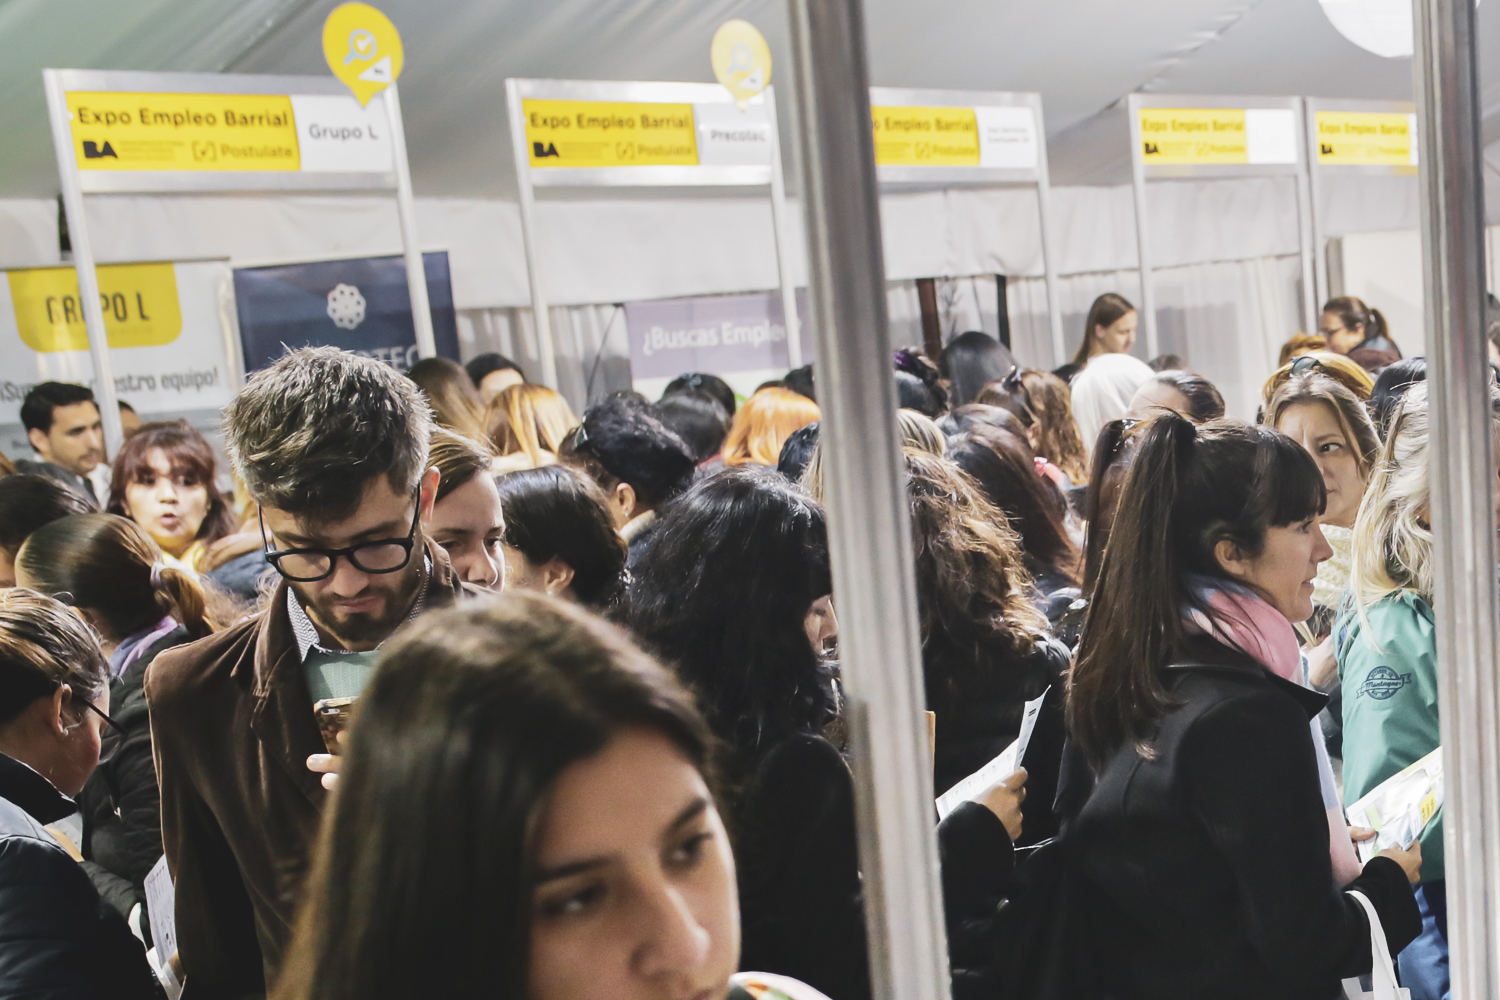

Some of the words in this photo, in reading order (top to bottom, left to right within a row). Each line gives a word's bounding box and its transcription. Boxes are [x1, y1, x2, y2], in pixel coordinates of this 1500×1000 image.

[77, 107, 131, 127] Expo
[139, 108, 216, 129] Empleo
[224, 110, 289, 127] Barrial
[530, 112, 570, 130] Expo
[577, 113, 635, 131] Empleo
[641, 114, 690, 130] Barrial
[309, 124, 362, 140] Grupo
[368, 125, 378, 139] L
[82, 141, 118, 159] BA
[533, 142, 560, 158] BA
[46, 292, 128, 324] GRPO
[138, 291, 151, 321] L
[643, 325, 719, 356] ¿Buscas
[161, 366, 218, 394] equipo!
